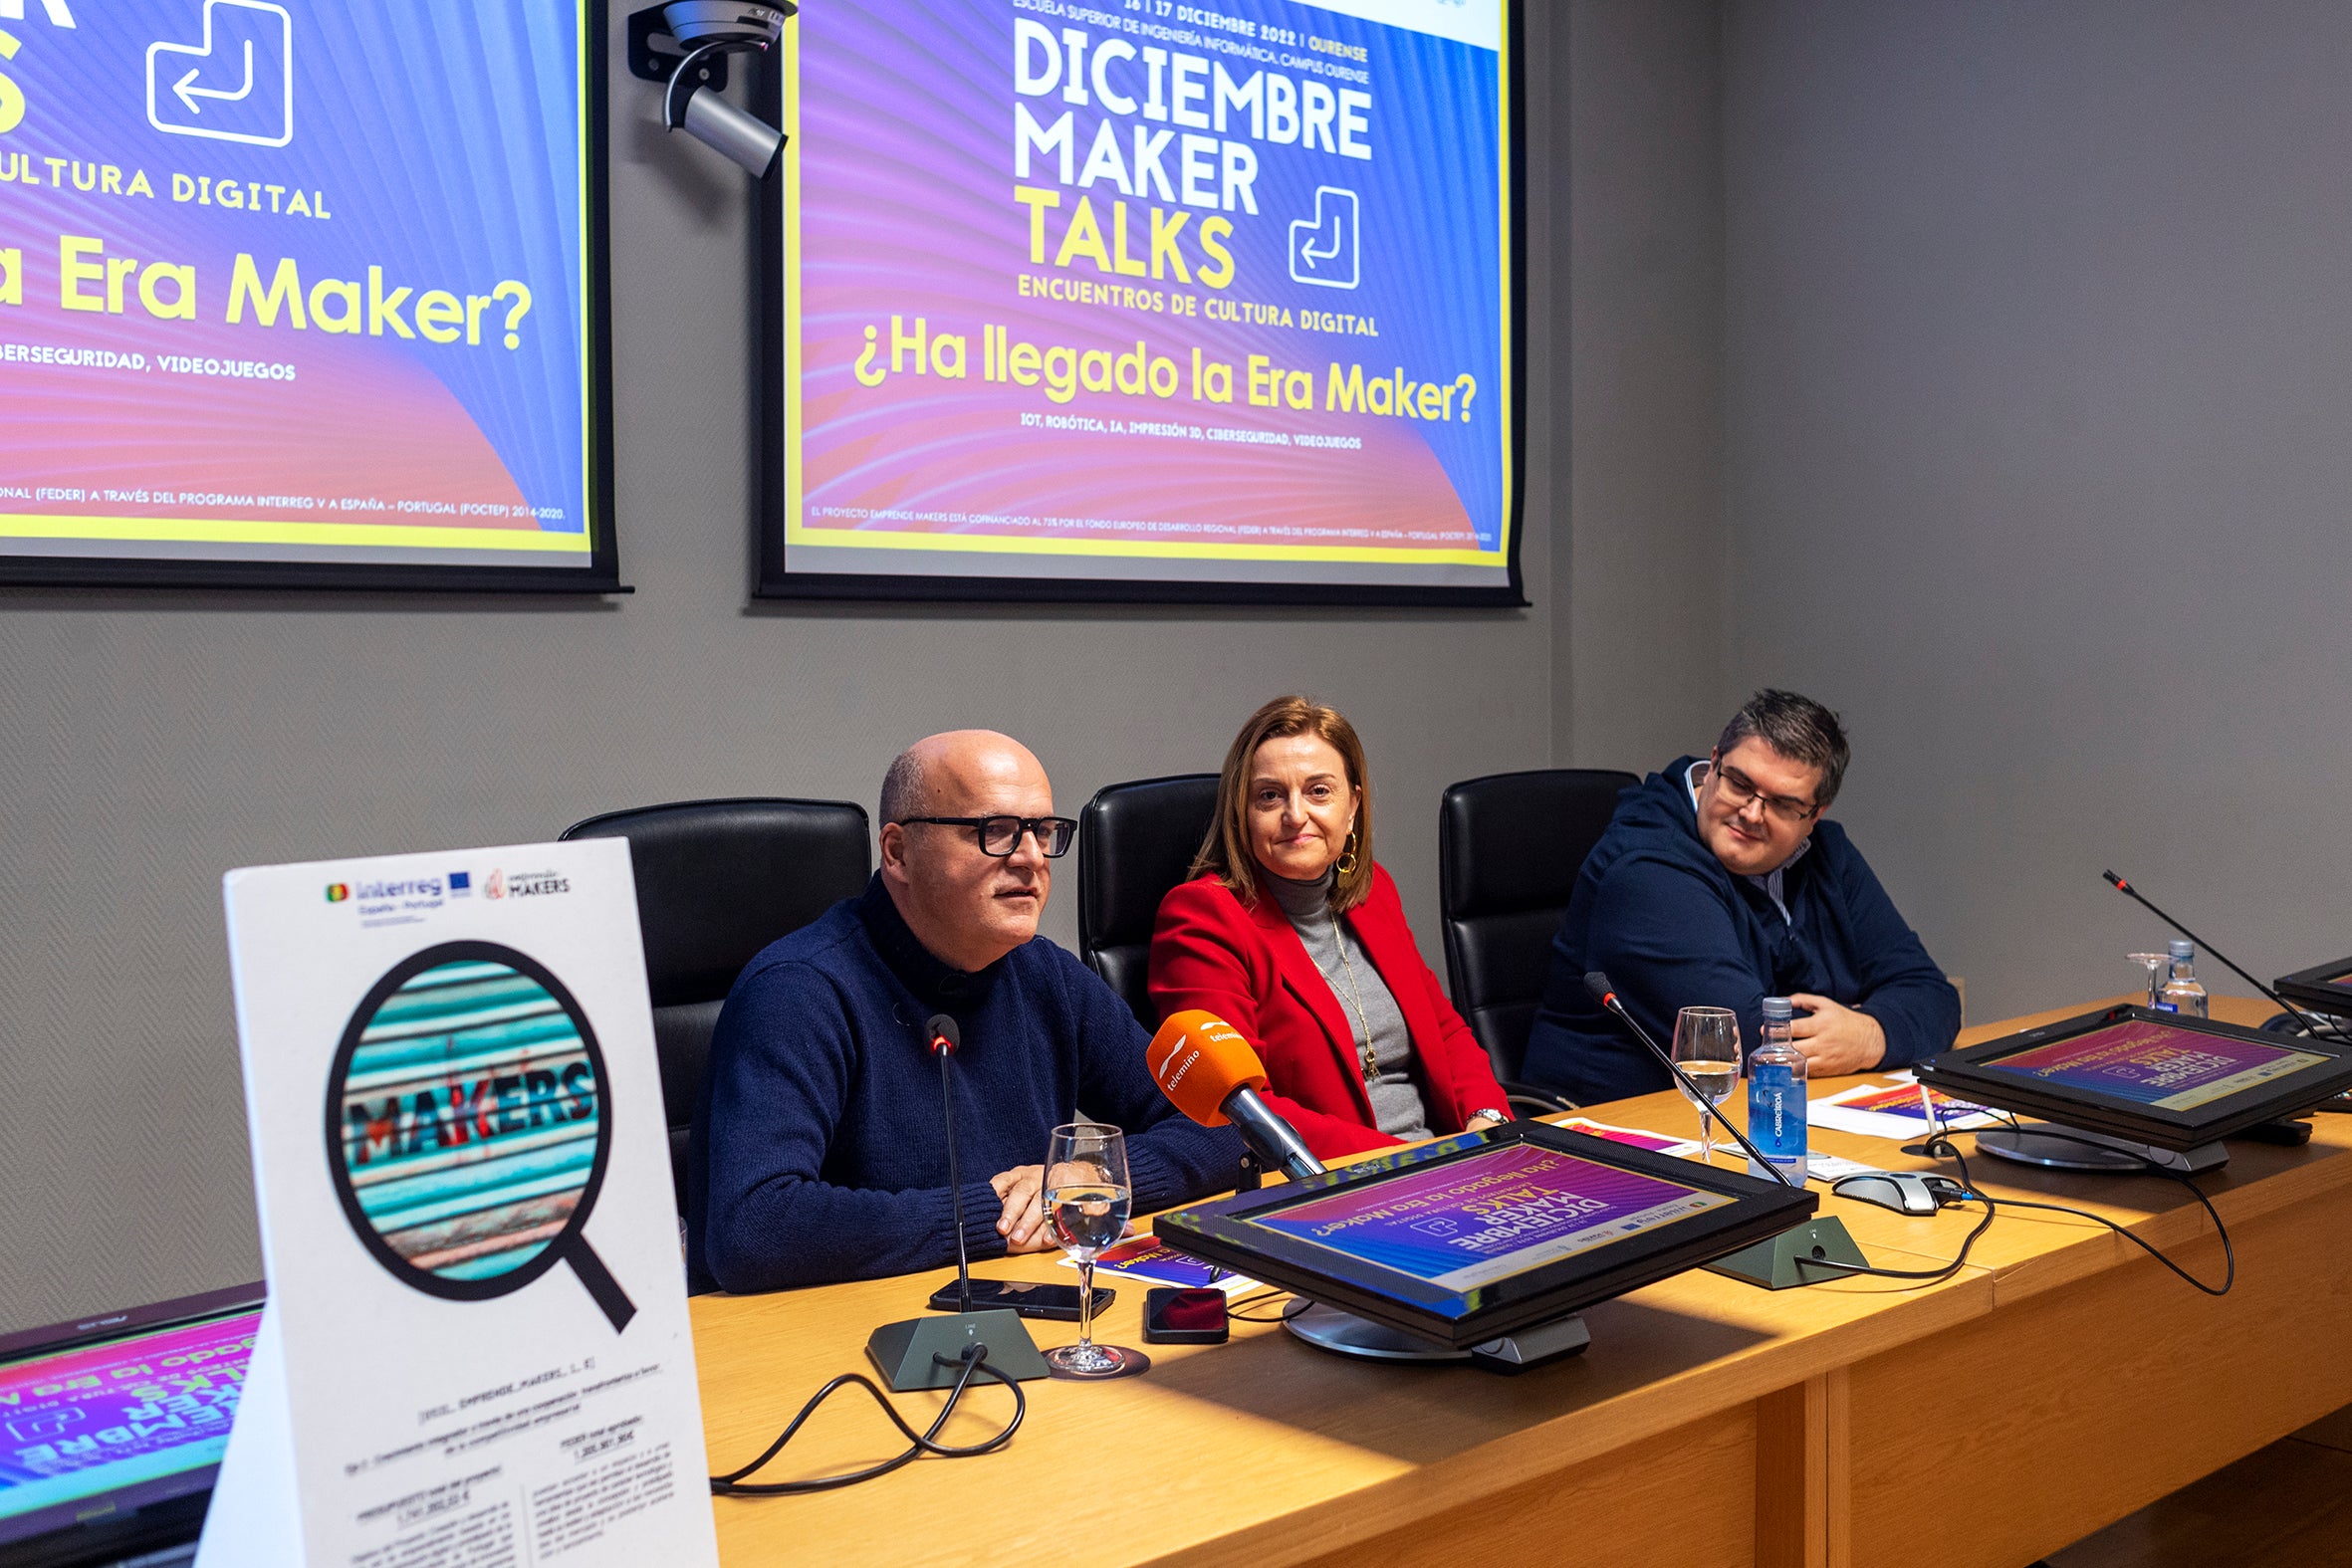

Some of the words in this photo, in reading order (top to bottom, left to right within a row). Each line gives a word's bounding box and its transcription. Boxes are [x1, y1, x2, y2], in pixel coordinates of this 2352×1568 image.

[1067, 5, 1122, 30] SUPERIOR
[1122, 18, 1140, 34] DE
[1280, 53, 1324, 76] CAMPUS
[1324, 63, 1369, 85] OURENSE
[1155, 0, 1172, 17] 17
[1177, 4, 1256, 38] DICIEMBRE
[1260, 25, 1295, 46] 2022
[1308, 35, 1368, 63] OURENSE
[1014, 17, 1372, 160] DICIEMBRE
[1014, 101, 1259, 216] MAKER
[172, 172, 332, 220] DIGITAL
[1014, 185, 1236, 289] TALKS
[60, 235, 196, 321] Era
[226, 252, 533, 350] Maker?
[1018, 273, 1165, 316] ENCUENTROS
[1171, 292, 1198, 318] DE
[1204, 296, 1294, 331] CULTURA
[1300, 308, 1380, 338] DIGITAL
[0, 343, 150, 372] ERSEGURIDAD,
[156, 354, 297, 381] VIDEOJUEGOS
[853, 314, 967, 387] ¿Ha
[983, 323, 1180, 404] llegado
[1192, 347, 1234, 406] la
[1248, 354, 1314, 412] Era
[1325, 365, 1478, 424] Maker?
[1021, 412, 1045, 428] IOT,
[1046, 414, 1107, 434] ROBÓTICA,
[1110, 421, 1127, 435] IA,
[1129, 421, 1187, 439] IMPRESIÓN
[1294, 434, 1362, 450] VIDEOJUEGOS
[36, 487, 86, 503] (FEDER)
[90, 489, 101, 501] A
[104, 488, 150, 503] TRAVÉS
[153, 492, 176, 504] DEL
[178, 492, 254, 507] PROGRAMA
[257, 496, 315, 509] INTERREG
[317, 498, 325, 509] V
[329, 499, 338, 510] A
[341, 497, 385, 512] ESPAÑA
[397, 501, 456, 515] PORTUGAL
[823, 507, 867, 519] PROYECTO
[870, 509, 914, 521] EMPRENDE
[915, 512, 947, 523] MAKERS
[1167, 1050, 1200, 1092] telemiño
[347, 1061, 597, 1165] MAKERS
[1449, 1172, 1529, 1195] llegado
[1462, 1186, 1560, 1216] TALKS
[1310, 1209, 1394, 1236] Maker?
[1389, 1199, 1431, 1212] Era
[1447, 1199, 1609, 1250] DICIEMBRE
[1474, 1191, 1584, 1226] MAKER
[34, 1376, 103, 1397] Era
[112, 1364, 153, 1379] la
